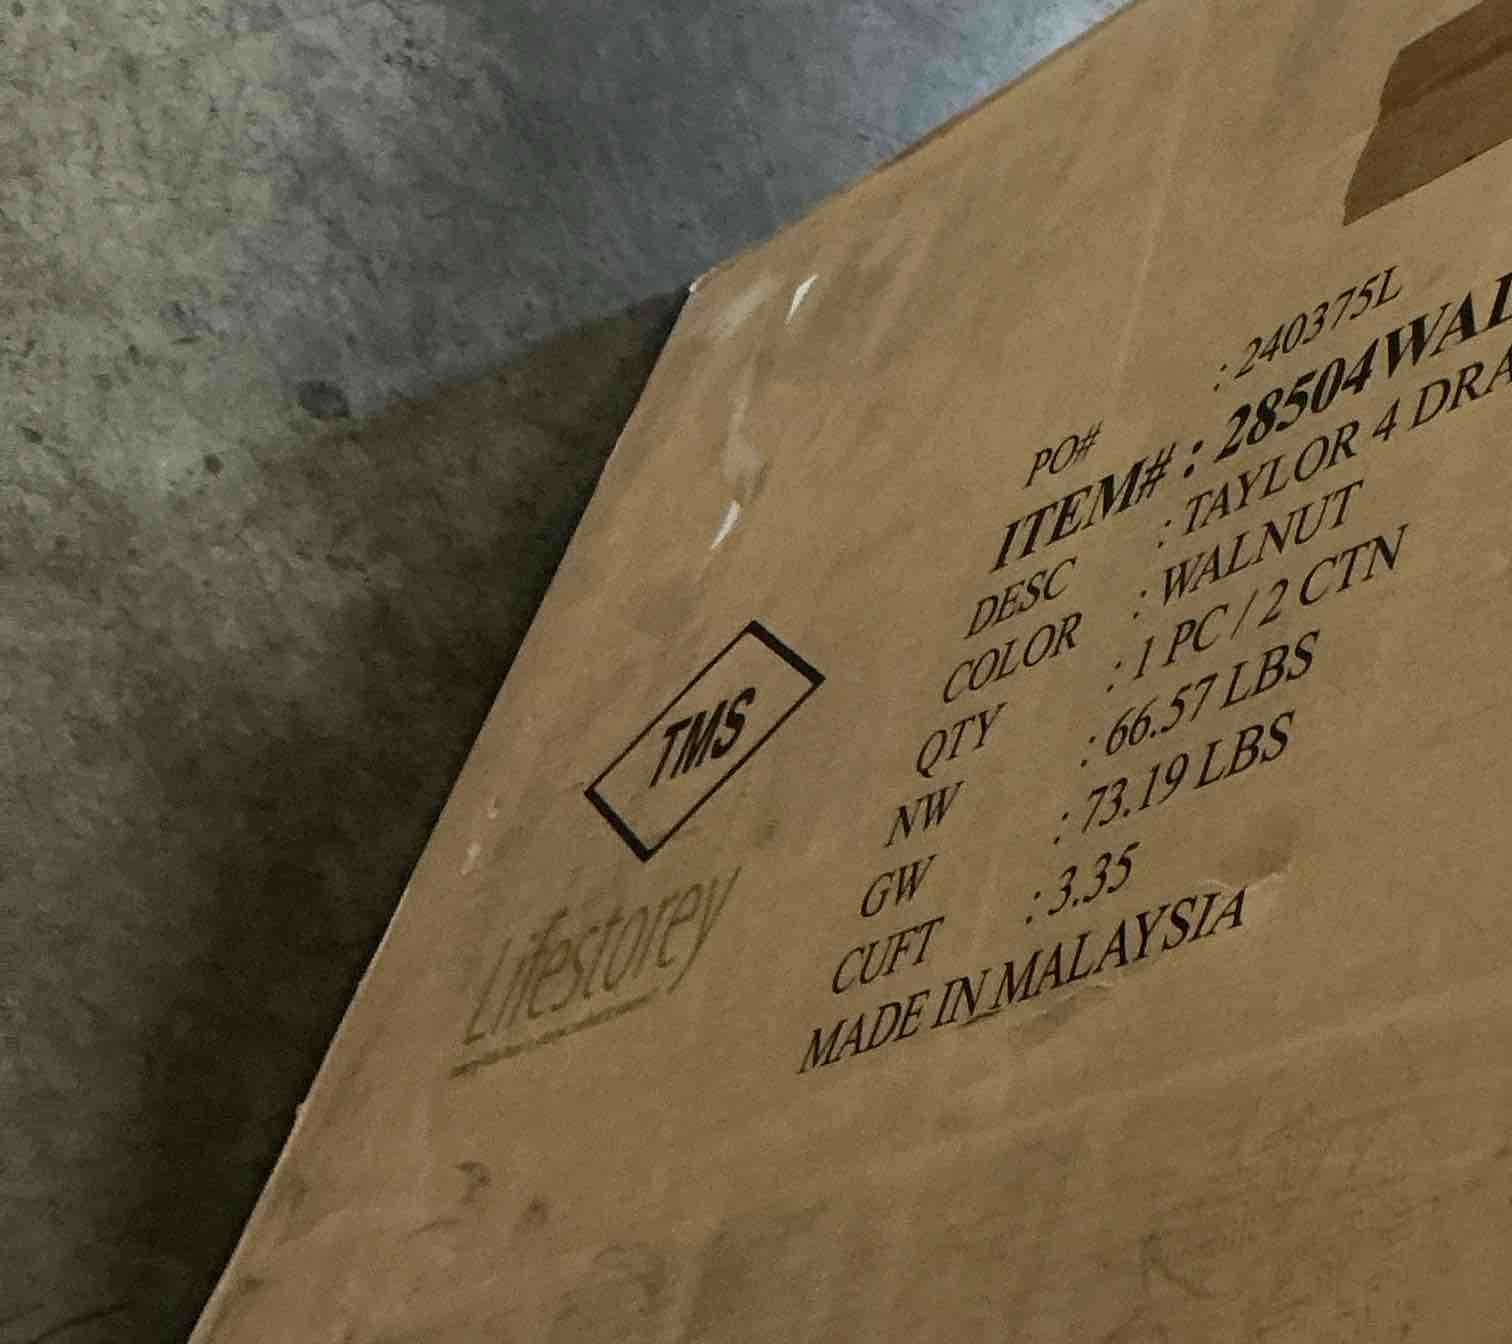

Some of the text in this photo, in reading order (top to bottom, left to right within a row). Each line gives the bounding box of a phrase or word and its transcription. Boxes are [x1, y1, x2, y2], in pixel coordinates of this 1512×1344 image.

[1025, 420, 1103, 487] PO#
[1234, 265, 1402, 379] 240375L
[941, 611, 1085, 707] COLOR
[1164, 480, 1363, 606] WALNUT
[965, 557, 1077, 640] DESC
[1183, 421, 1360, 537] TAYLOR
[1372, 396, 1401, 443] 4
[990, 442, 1176, 572] ITEM#
[650, 687, 757, 788] TMS
[886, 783, 963, 847] NW
[1105, 676, 1217, 756] 66.57
[1218, 633, 1319, 709] LBS
[914, 702, 1006, 780] QTY
[1132, 630, 1157, 685] 1
[1160, 603, 1229, 676] PC
[1258, 576, 1292, 628] 2
[1298, 527, 1408, 615] CTN
[829, 918, 943, 996] CUFT
[1048, 842, 1141, 917] 3.35
[859, 857, 933, 920] GW
[1080, 763, 1191, 836] 73.19
[1194, 713, 1296, 788] LBS
[463, 865, 742, 1046] Lifestorey
[799, 886, 1248, 1074] MADE IN MALAYSIA
